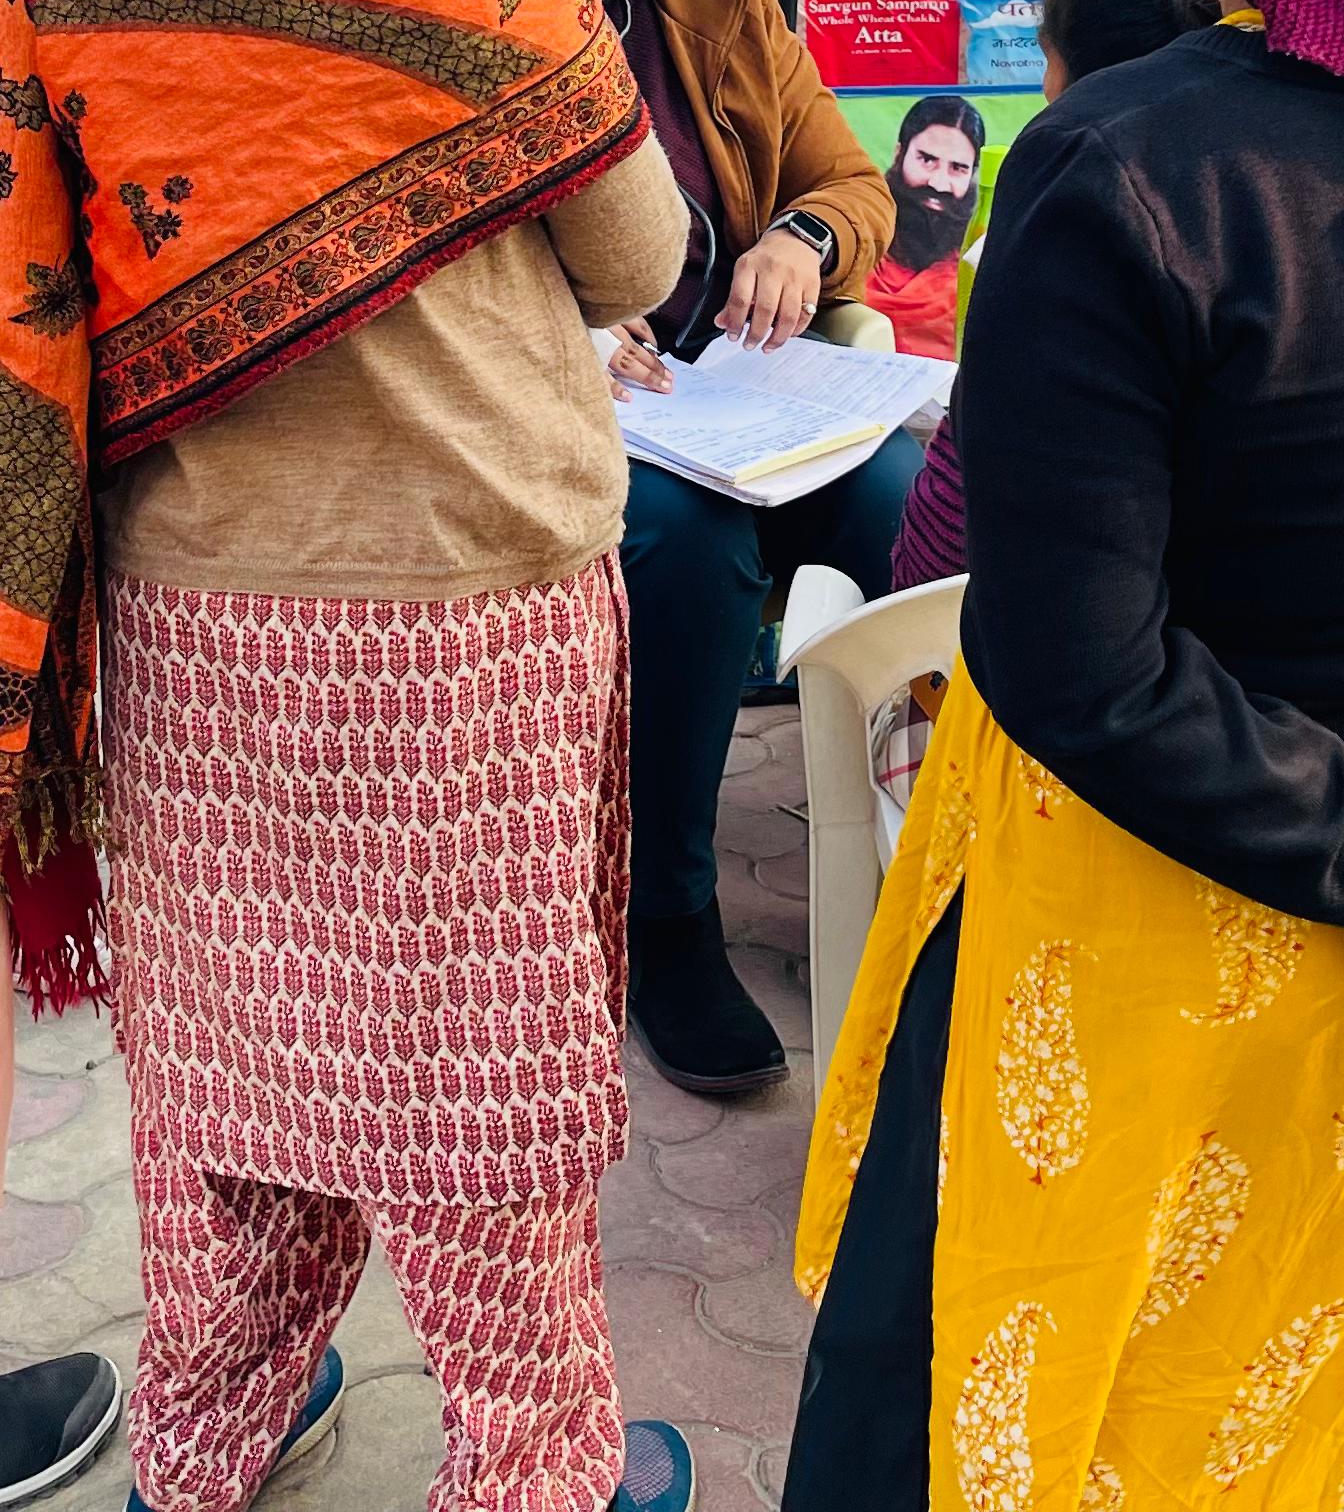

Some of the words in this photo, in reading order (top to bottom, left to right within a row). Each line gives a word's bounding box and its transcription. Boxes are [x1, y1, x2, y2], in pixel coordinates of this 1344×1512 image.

[808, 0, 872, 16] Sarvgun
[818, 16, 854, 26] Whole
[858, 14, 895, 25] Wheat
[897, 13, 941, 24] Chakki
[854, 26, 904, 44] Atta
